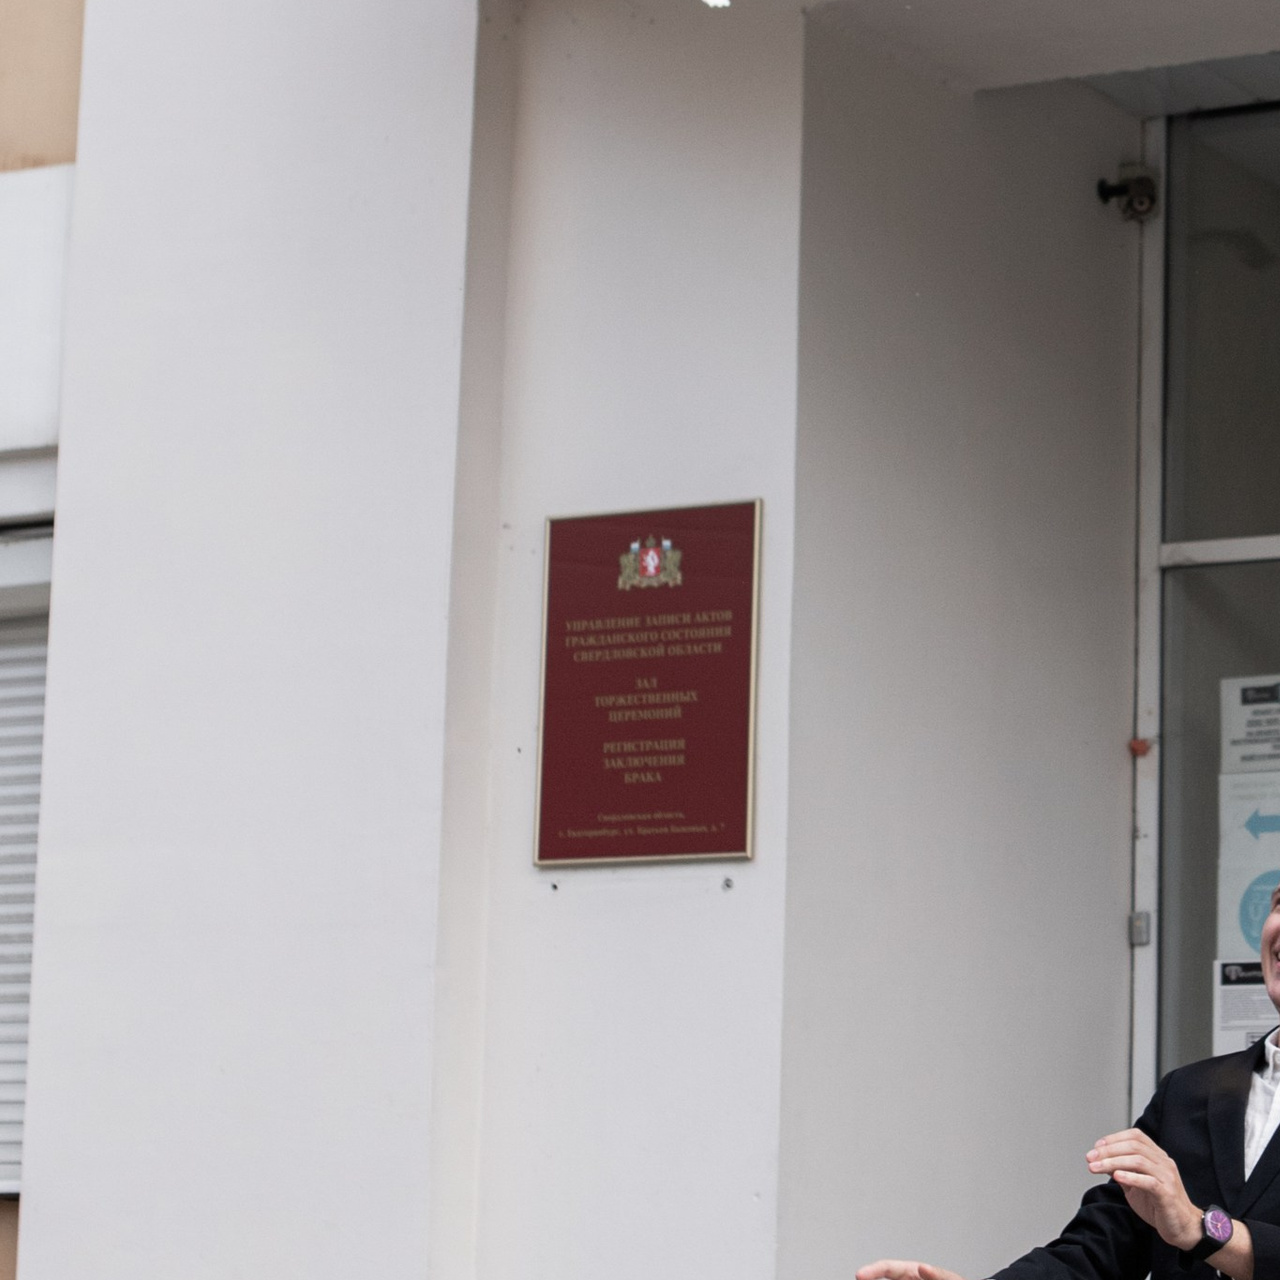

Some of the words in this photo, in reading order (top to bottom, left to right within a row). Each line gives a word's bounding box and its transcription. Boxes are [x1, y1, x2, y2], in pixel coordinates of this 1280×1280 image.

[566, 617, 641, 632] УПРАВЛЕНИЕ
[647, 613, 690, 627] ЗАПИСИ
[695, 610, 732, 623] АКТОВ
[566, 631, 657, 648] ГРАЖДАНСКОГО
[662, 626, 732, 640] СОСТОЯНИЯ
[574, 644, 664, 663] СВЕРДЛОВСКОЙ
[669, 642, 722, 657] ОБЛАСТИ
[636, 678, 657, 690] ЗАЛ
[596, 691, 697, 708] ТОРЖЕСТВЕННЫХ
[609, 705, 682, 723] ЦЕРЕМОНИЙ
[604, 739, 685, 754] РЕГИСТРАЦИЯ
[604, 755, 685, 770] ЗАКЛЮЧЕНИЯ
[625, 772, 662, 784] БРАКА
